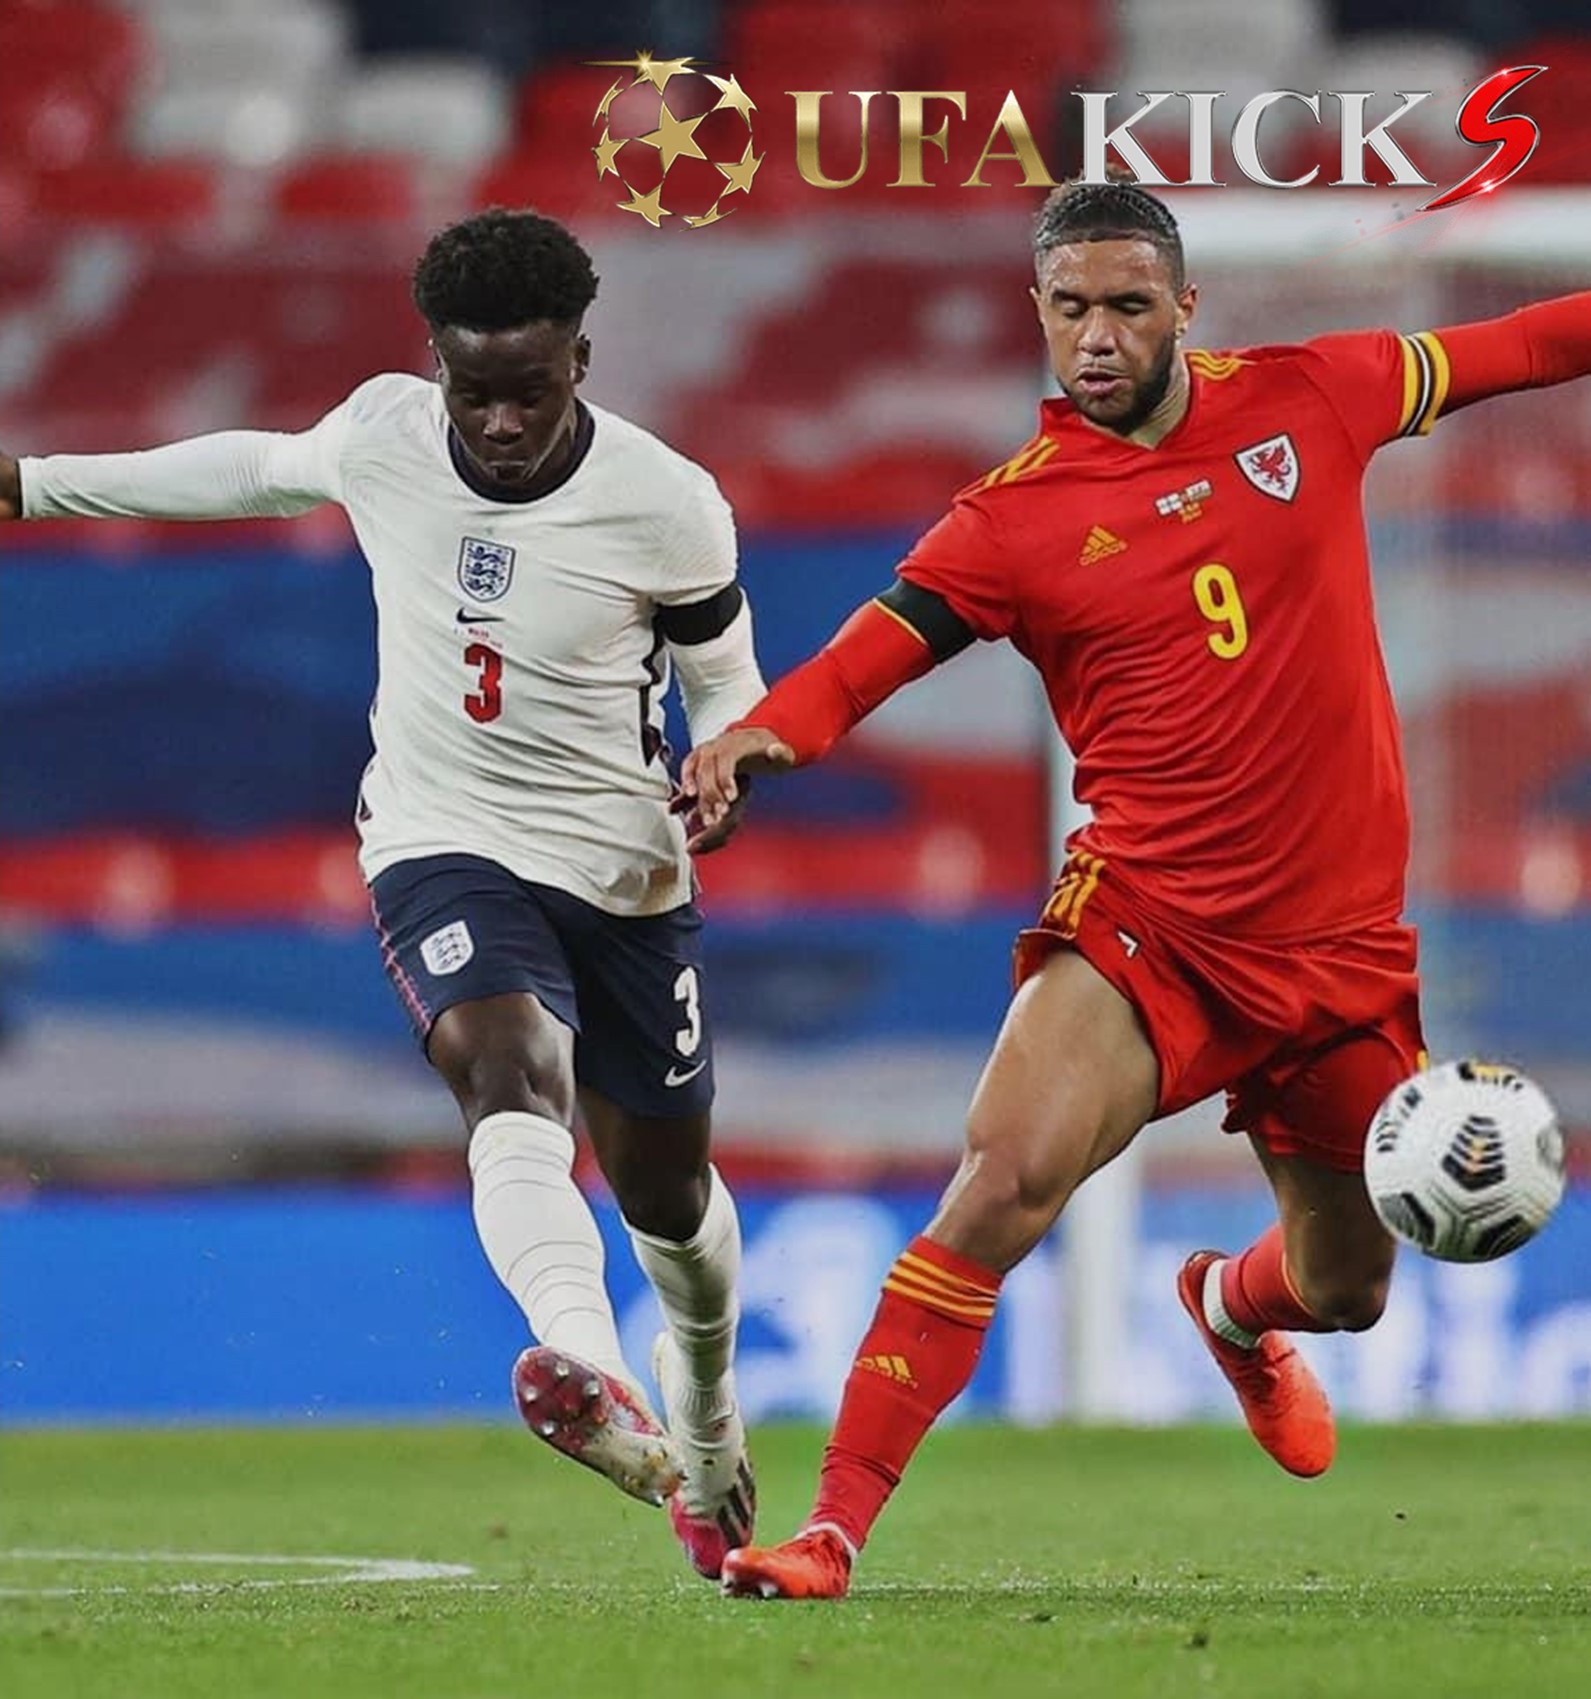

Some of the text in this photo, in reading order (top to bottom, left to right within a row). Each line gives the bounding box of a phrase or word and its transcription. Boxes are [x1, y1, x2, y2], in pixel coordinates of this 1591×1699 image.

[1193, 563, 1248, 660] 9
[463, 642, 503, 724] 3
[674, 965, 701, 1057] 3
